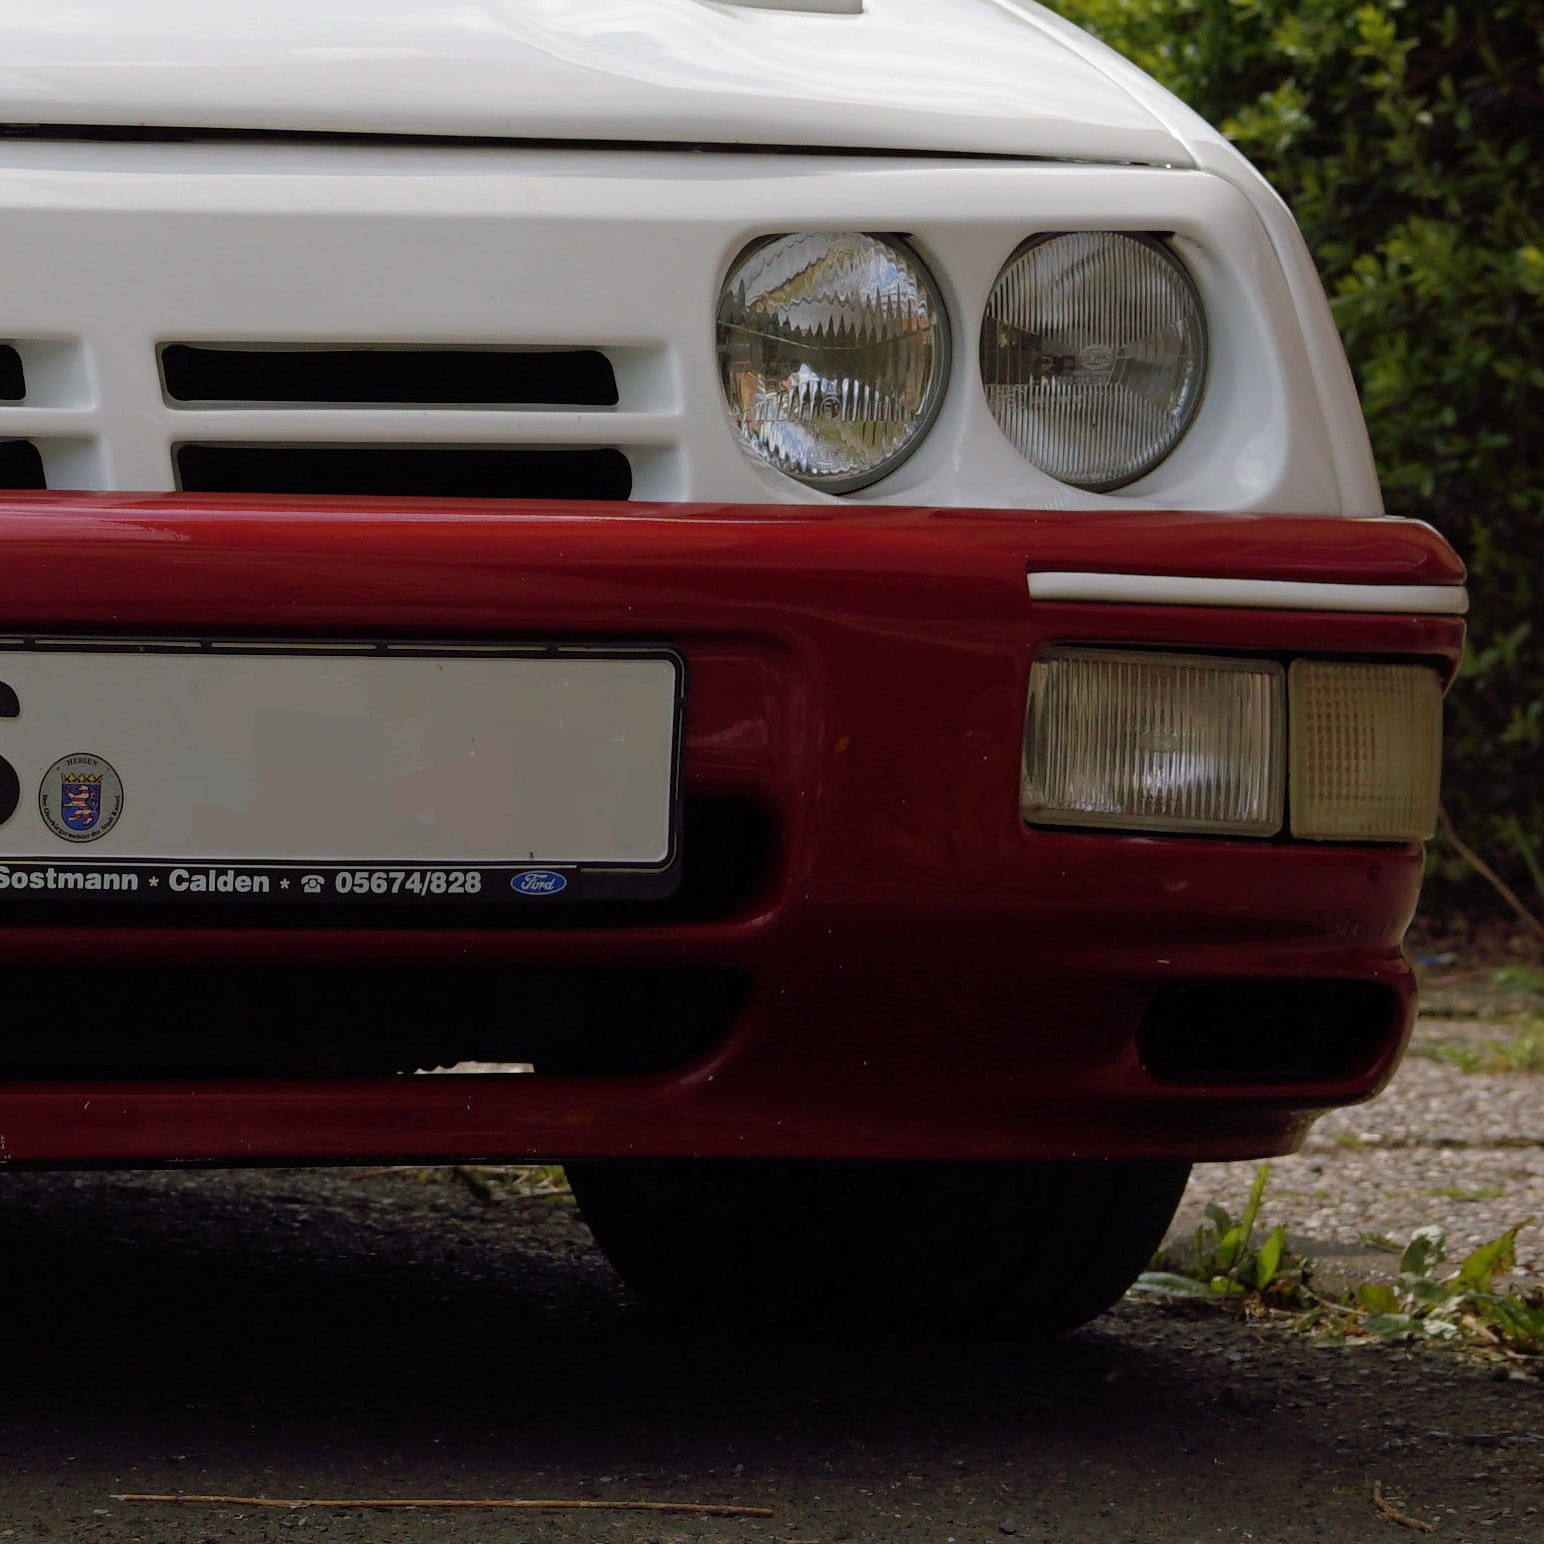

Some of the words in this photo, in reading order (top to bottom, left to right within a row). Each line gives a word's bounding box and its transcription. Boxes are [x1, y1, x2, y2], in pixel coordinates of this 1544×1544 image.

[168, 868, 270, 893] Calden
[335, 871, 482, 896] 05674/828
[520, 873, 556, 892] Ford
